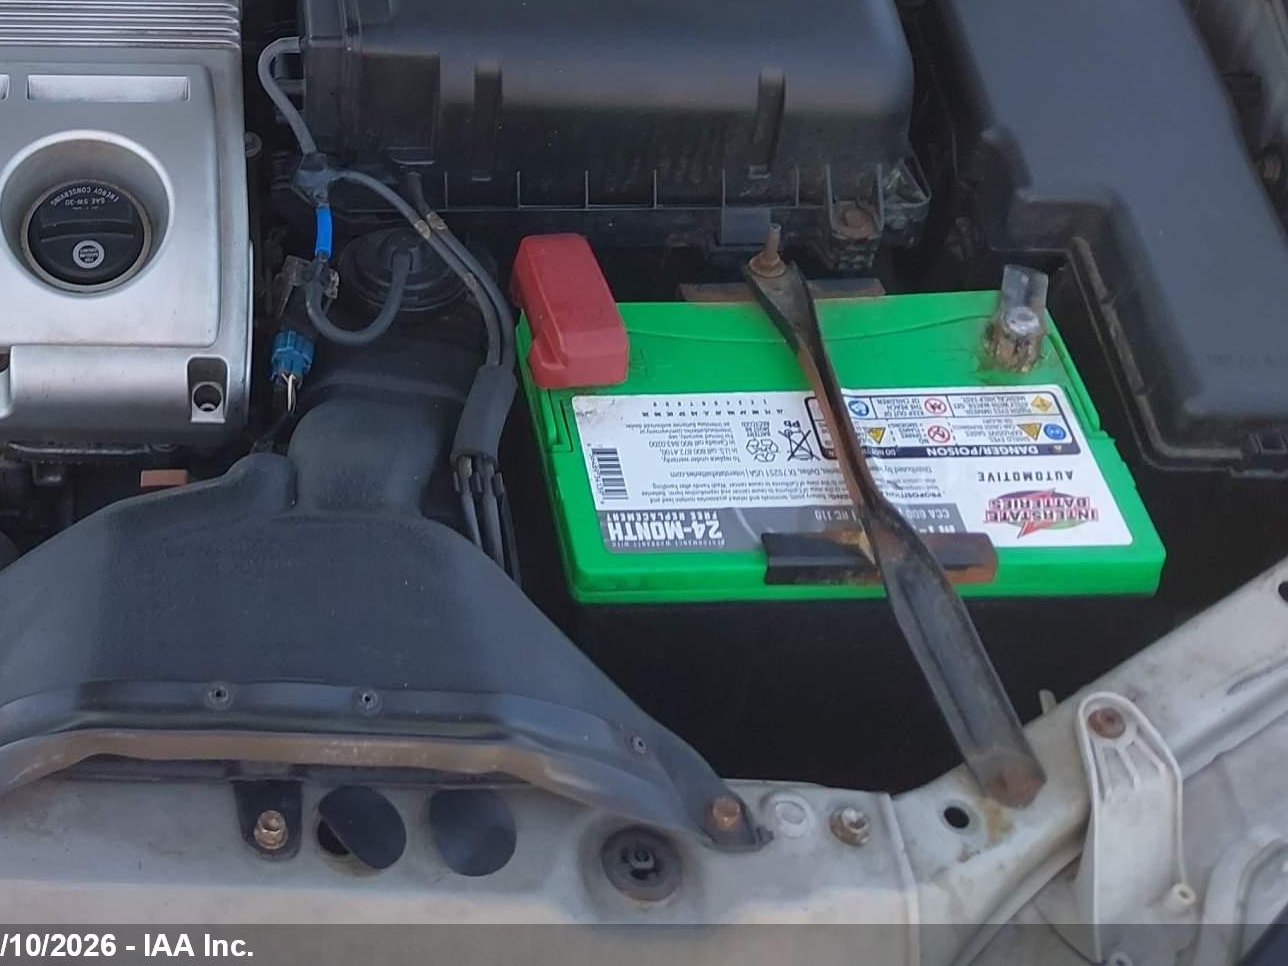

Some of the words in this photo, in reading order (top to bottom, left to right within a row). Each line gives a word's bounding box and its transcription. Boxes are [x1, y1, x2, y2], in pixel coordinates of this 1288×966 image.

[783, 420, 800, 428] Pb
[926, 445, 1039, 456] DANGER/POISON
[977, 470, 1073, 482] AUTOMOTIVE
[988, 497, 1089, 510] BATTERIES
[606, 511, 685, 522] REPLACEMENT
[690, 511, 717, 521] FREE
[985, 509, 1098, 523] INTERSTATE
[607, 520, 722, 541] 24-MONTH
